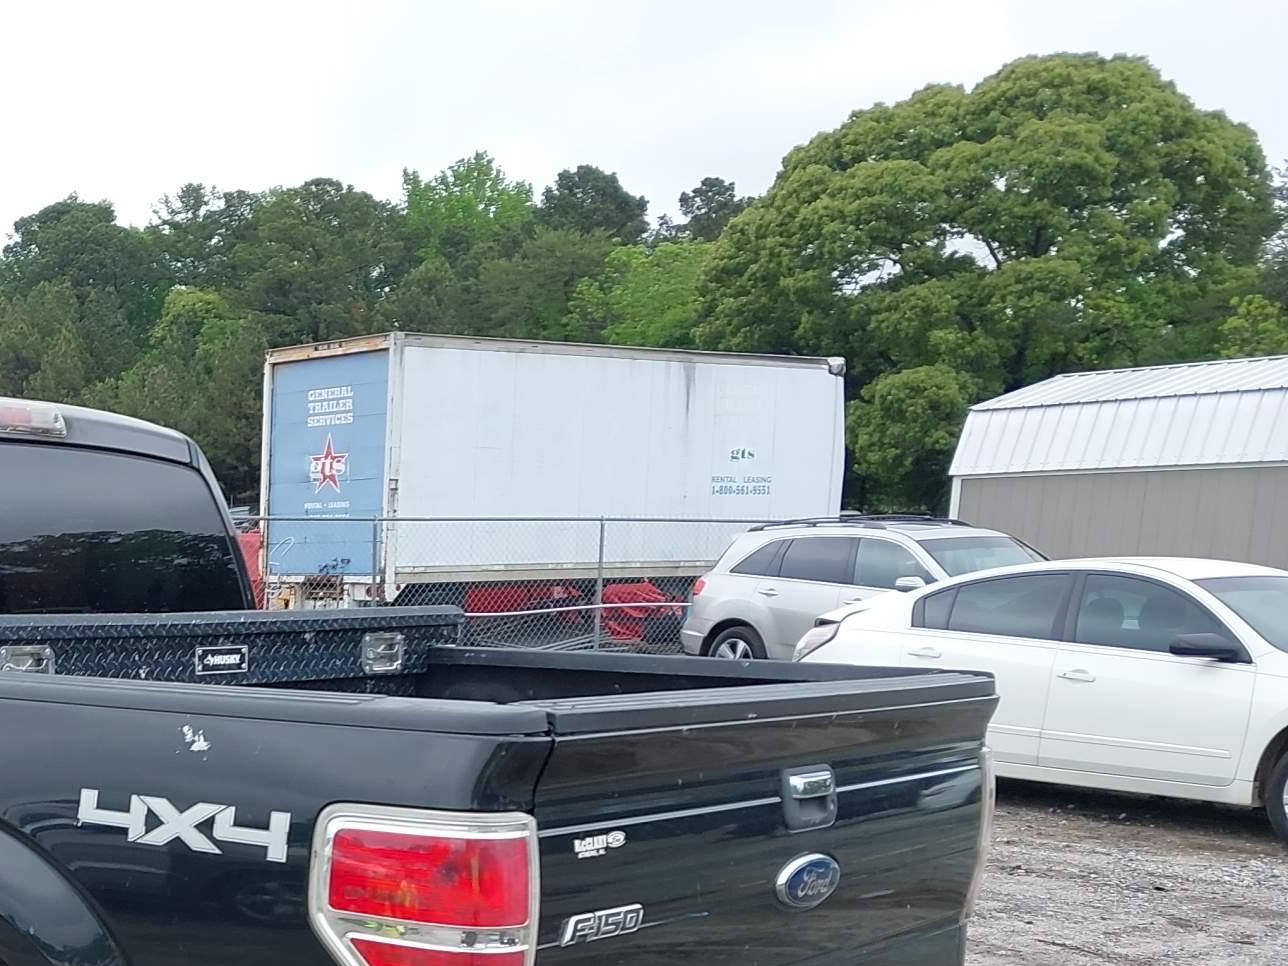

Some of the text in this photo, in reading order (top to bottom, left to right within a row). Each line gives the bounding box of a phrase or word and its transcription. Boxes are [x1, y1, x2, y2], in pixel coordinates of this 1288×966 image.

[307, 386, 354, 401] GENERAL
[307, 399, 353, 413] TRAILER
[307, 412, 354, 427] SERVICES
[730, 447, 755, 462] gts
[214, 654, 241, 665] HUSKY
[798, 866, 832, 898] Ford
